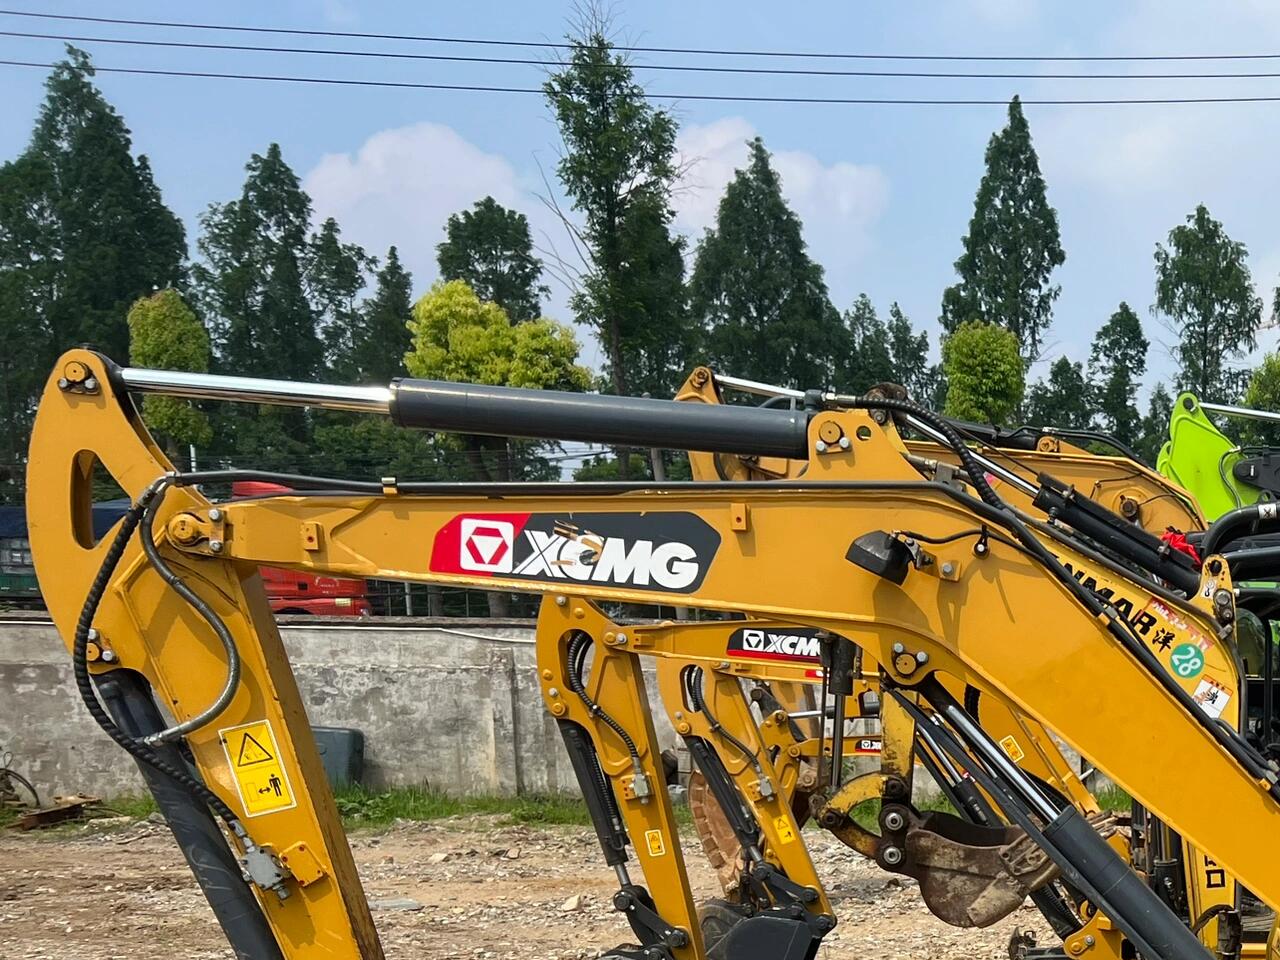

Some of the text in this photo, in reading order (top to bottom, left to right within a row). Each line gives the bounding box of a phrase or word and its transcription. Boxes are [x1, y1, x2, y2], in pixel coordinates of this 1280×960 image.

[512, 530, 699, 588] XCMG
[764, 633, 821, 656] XCM
[1171, 646, 1202, 676] 28
